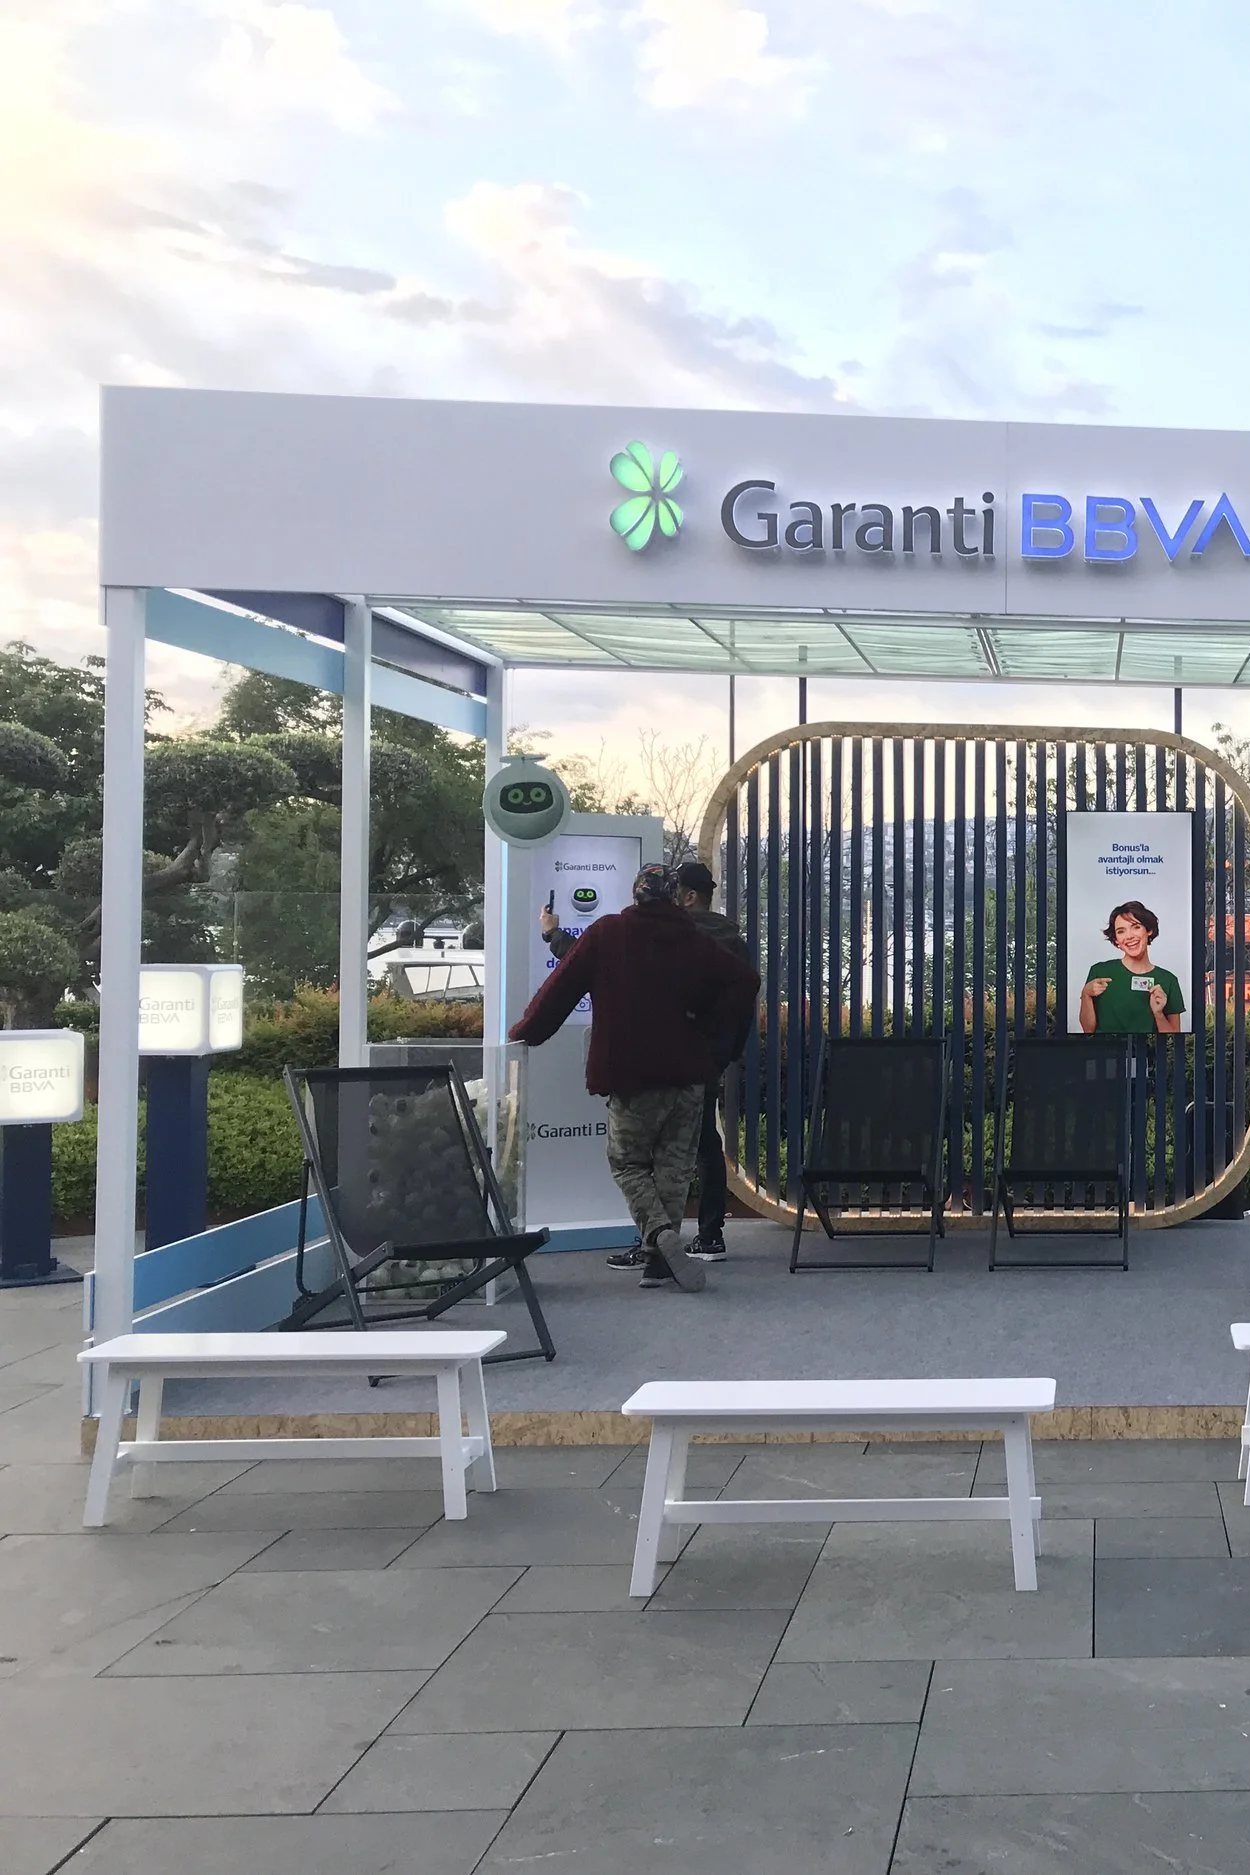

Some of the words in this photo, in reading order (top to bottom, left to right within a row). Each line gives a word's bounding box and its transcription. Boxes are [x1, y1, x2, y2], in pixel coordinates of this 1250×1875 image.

[719, 479, 997, 557] Garanti
[1112, 843, 1150, 852] Bonus'la
[1136, 855, 1164, 864] olmak
[563, 862, 591, 871] Garanti
[592, 864, 617, 872] BBVA
[139, 997, 195, 1011] Garanti
[139, 1013, 180, 1024] BBVA
[9, 1065, 71, 1080] Garanti
[10, 1080, 55, 1093] BBVA
[537, 1123, 592, 1139] Garanti
